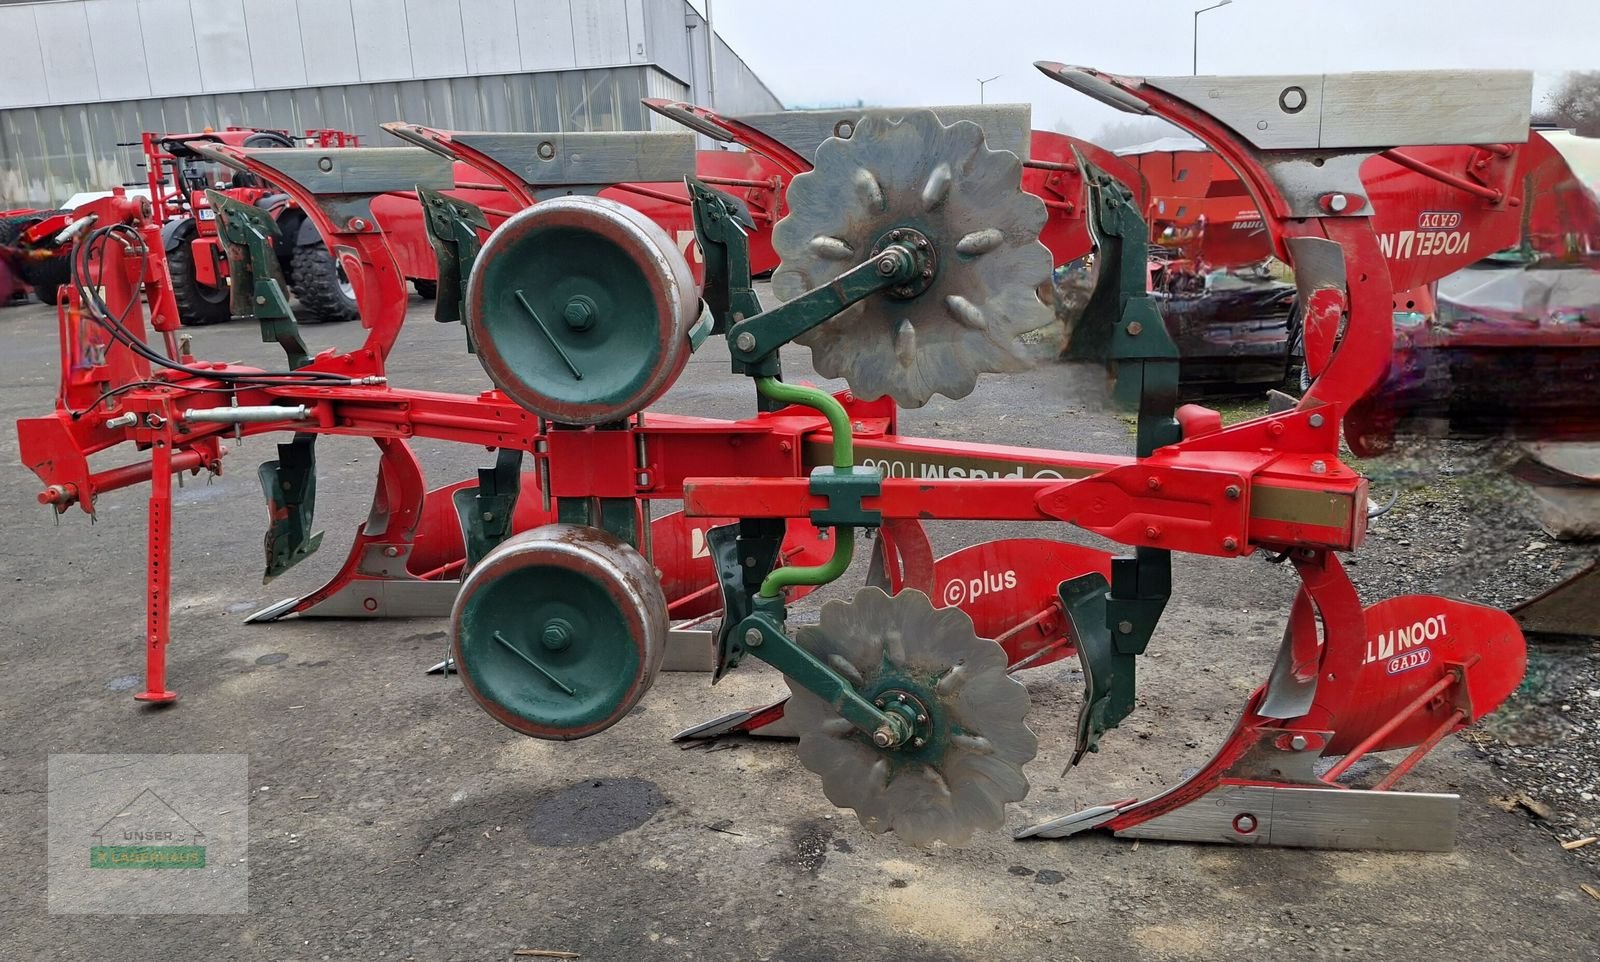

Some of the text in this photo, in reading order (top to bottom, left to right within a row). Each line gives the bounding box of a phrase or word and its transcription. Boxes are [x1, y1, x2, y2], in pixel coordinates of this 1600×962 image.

[1422, 214, 1458, 228] GADY
[1416, 231, 1470, 256] VOGEL
[1398, 614, 1448, 651] NOOT
[1391, 651, 1428, 672] GADY
